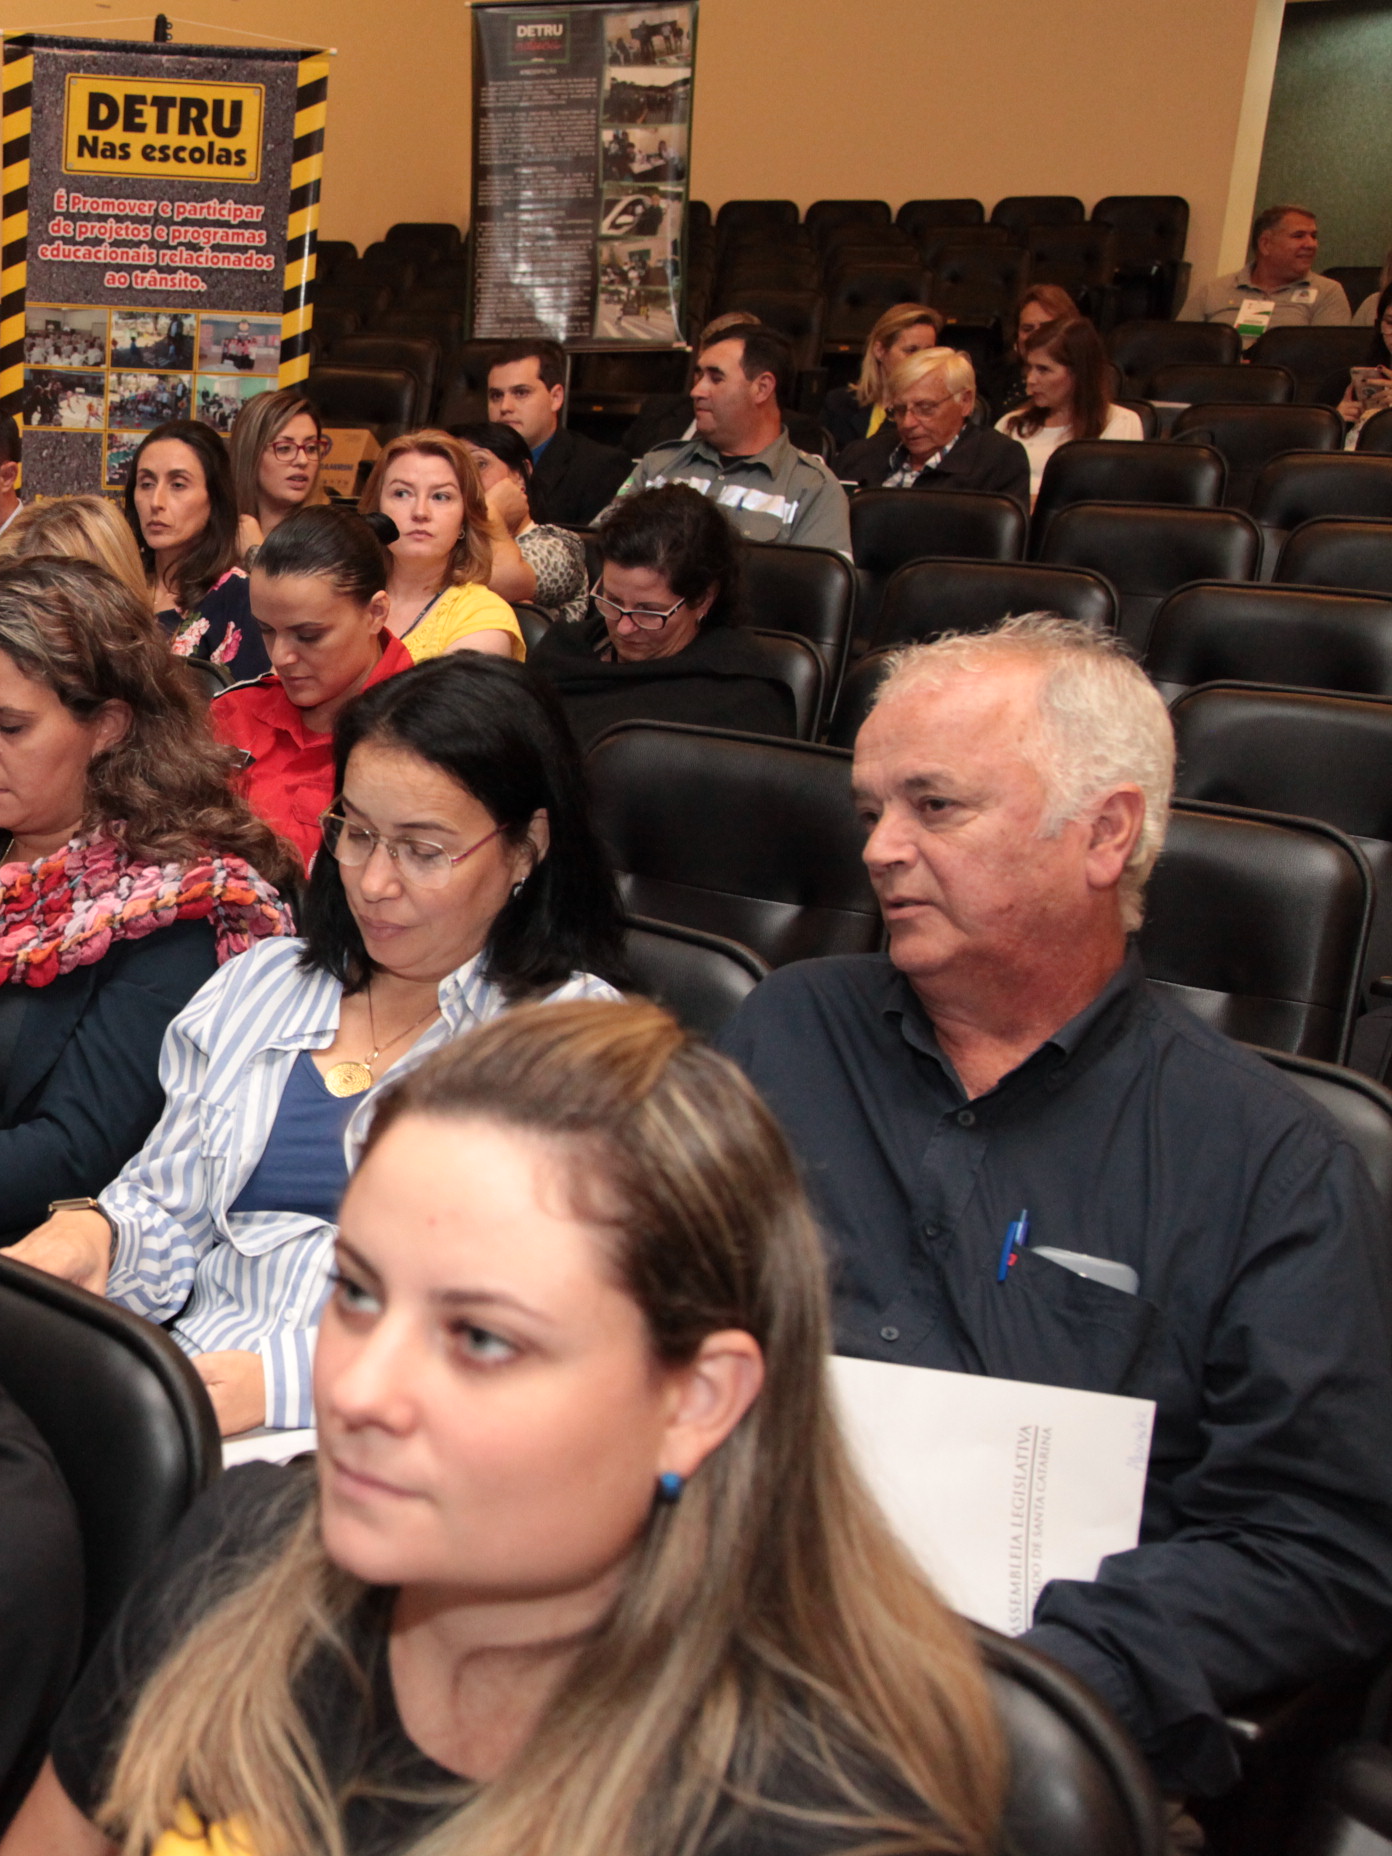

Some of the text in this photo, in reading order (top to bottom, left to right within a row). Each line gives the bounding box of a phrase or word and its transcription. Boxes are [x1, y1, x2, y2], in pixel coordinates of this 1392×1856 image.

[516, 24, 563, 38] DETRU
[87, 91, 243, 138] DETRU
[77, 135, 247, 167] Nas escolas
[54, 188, 265, 223] É Promover e participar
[49, 216, 267, 245] de projetos e programas
[38, 241, 275, 270] educacionais relacionados
[105, 268, 207, 291] ao trânsito.
[1036, 1427, 1053, 1492] CATARINA
[1008, 1425, 1032, 1637] ASSEMBLEIA LEGISLATIVA
[1032, 1496, 1046, 1537] SANTA
